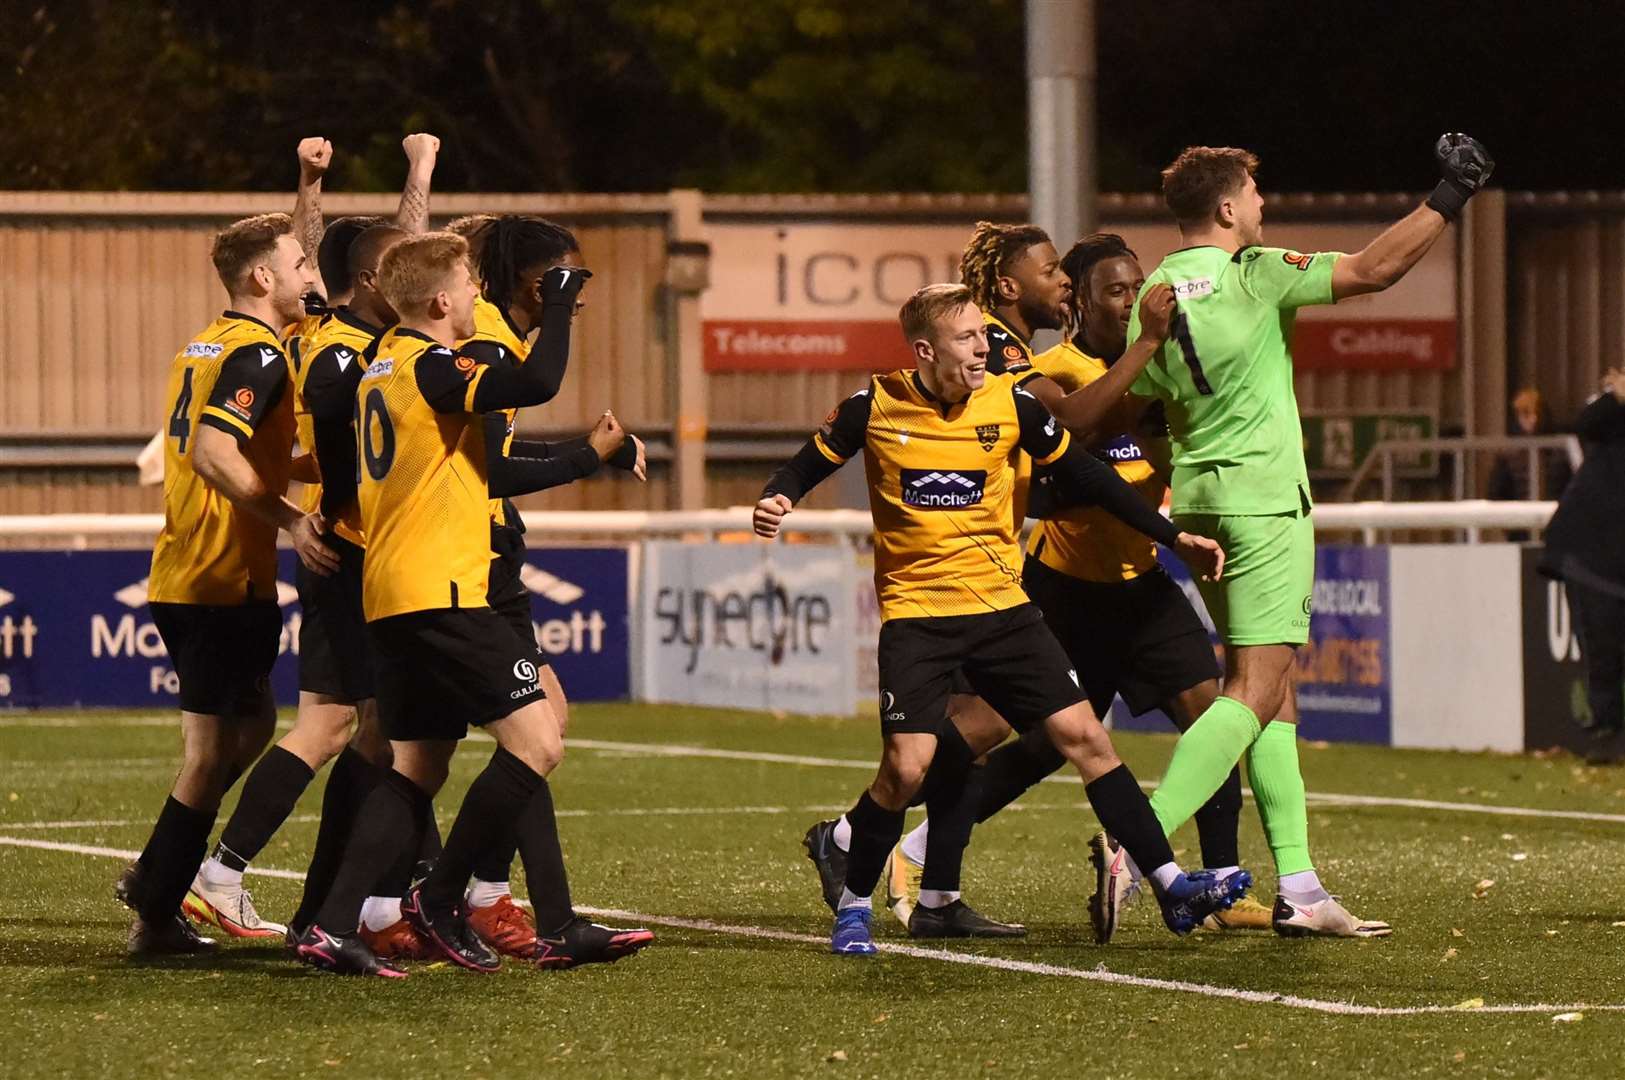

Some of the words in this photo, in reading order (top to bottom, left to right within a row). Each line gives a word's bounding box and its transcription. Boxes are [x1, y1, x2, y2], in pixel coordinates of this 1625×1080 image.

[775, 229, 964, 306] ico
[713, 328, 847, 355] Telecoms
[1169, 313, 1215, 396] 1
[1329, 328, 1434, 362] Cabling
[169, 366, 194, 454] 4
[1107, 443, 1142, 459] nch
[905, 488, 983, 506] Manchett
[1547, 578, 1581, 661] U
